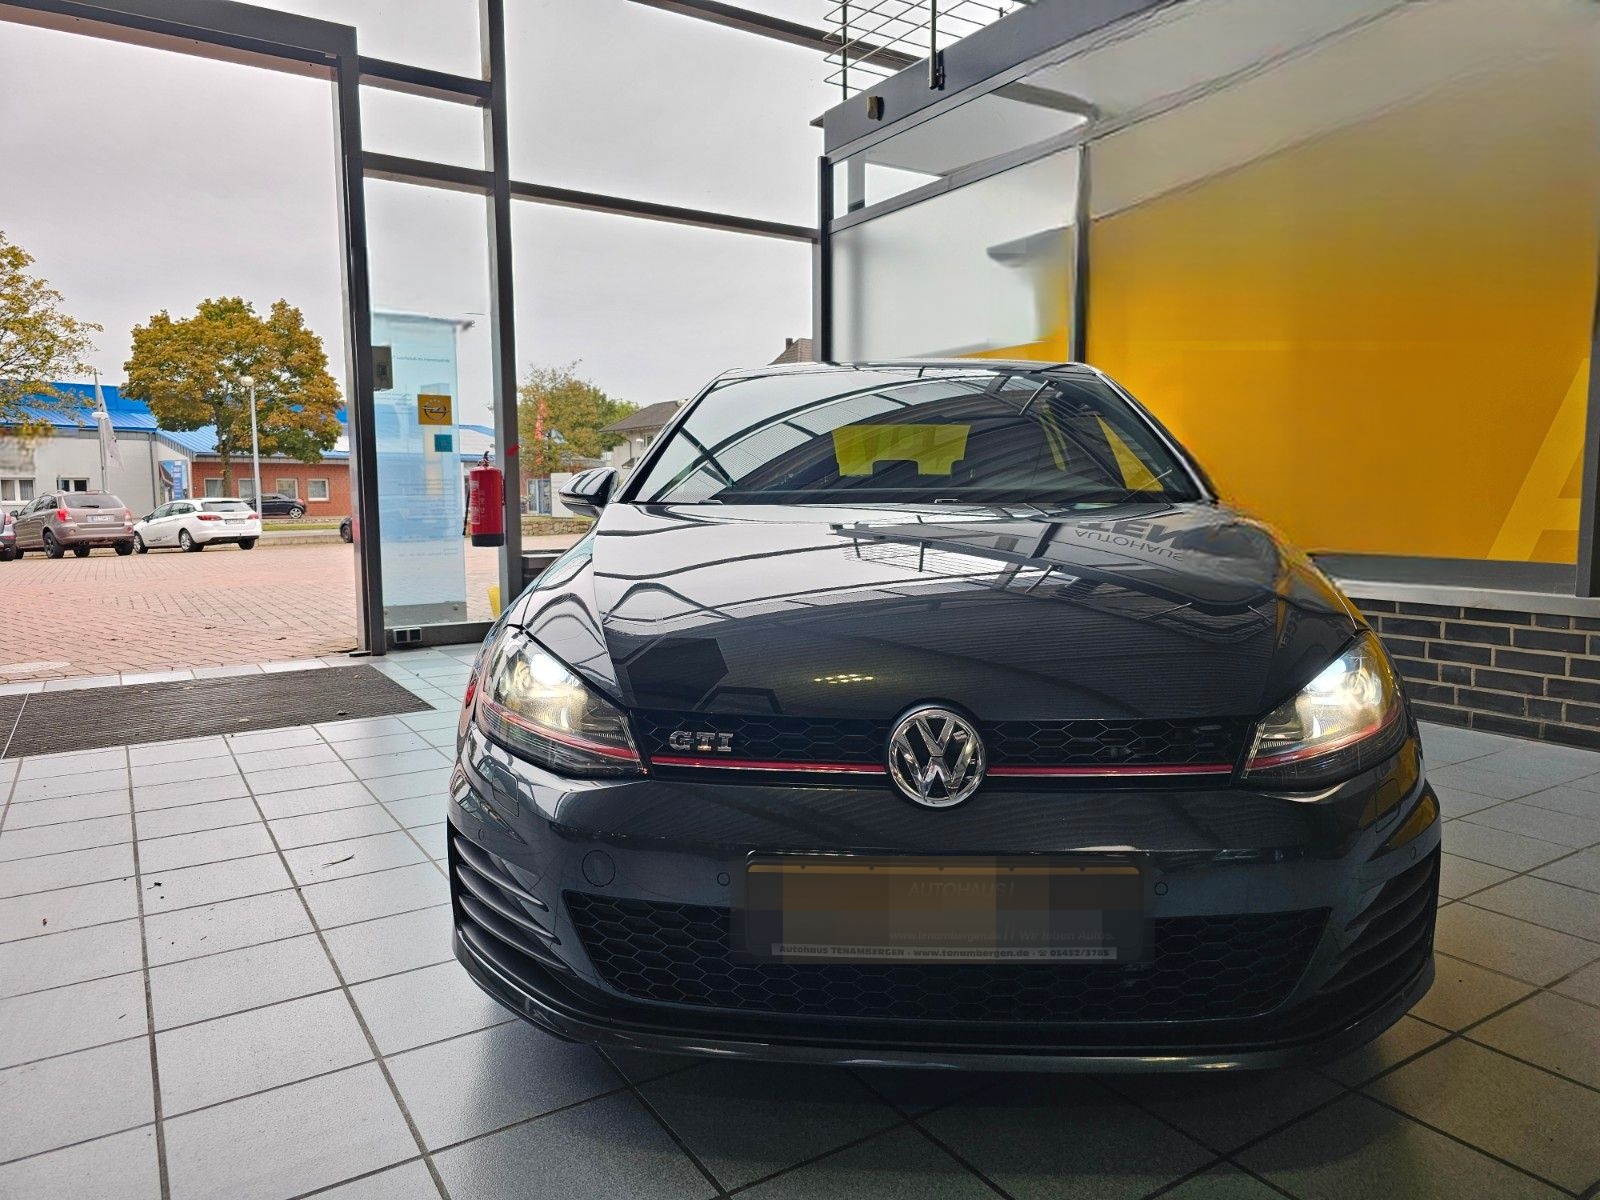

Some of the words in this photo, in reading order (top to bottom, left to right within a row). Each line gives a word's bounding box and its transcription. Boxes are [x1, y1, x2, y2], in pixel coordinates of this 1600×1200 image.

[669, 730, 734, 752] GTI
[890, 707, 985, 807] VW
[907, 882, 1007, 898] AUTOHAUS
[1042, 930, 1075, 940] leben
[779, 945, 828, 954] Autohaus
[831, 947, 905, 956] TENAMBERGEN
[913, 949, 1030, 957] www.tenambergen.de
